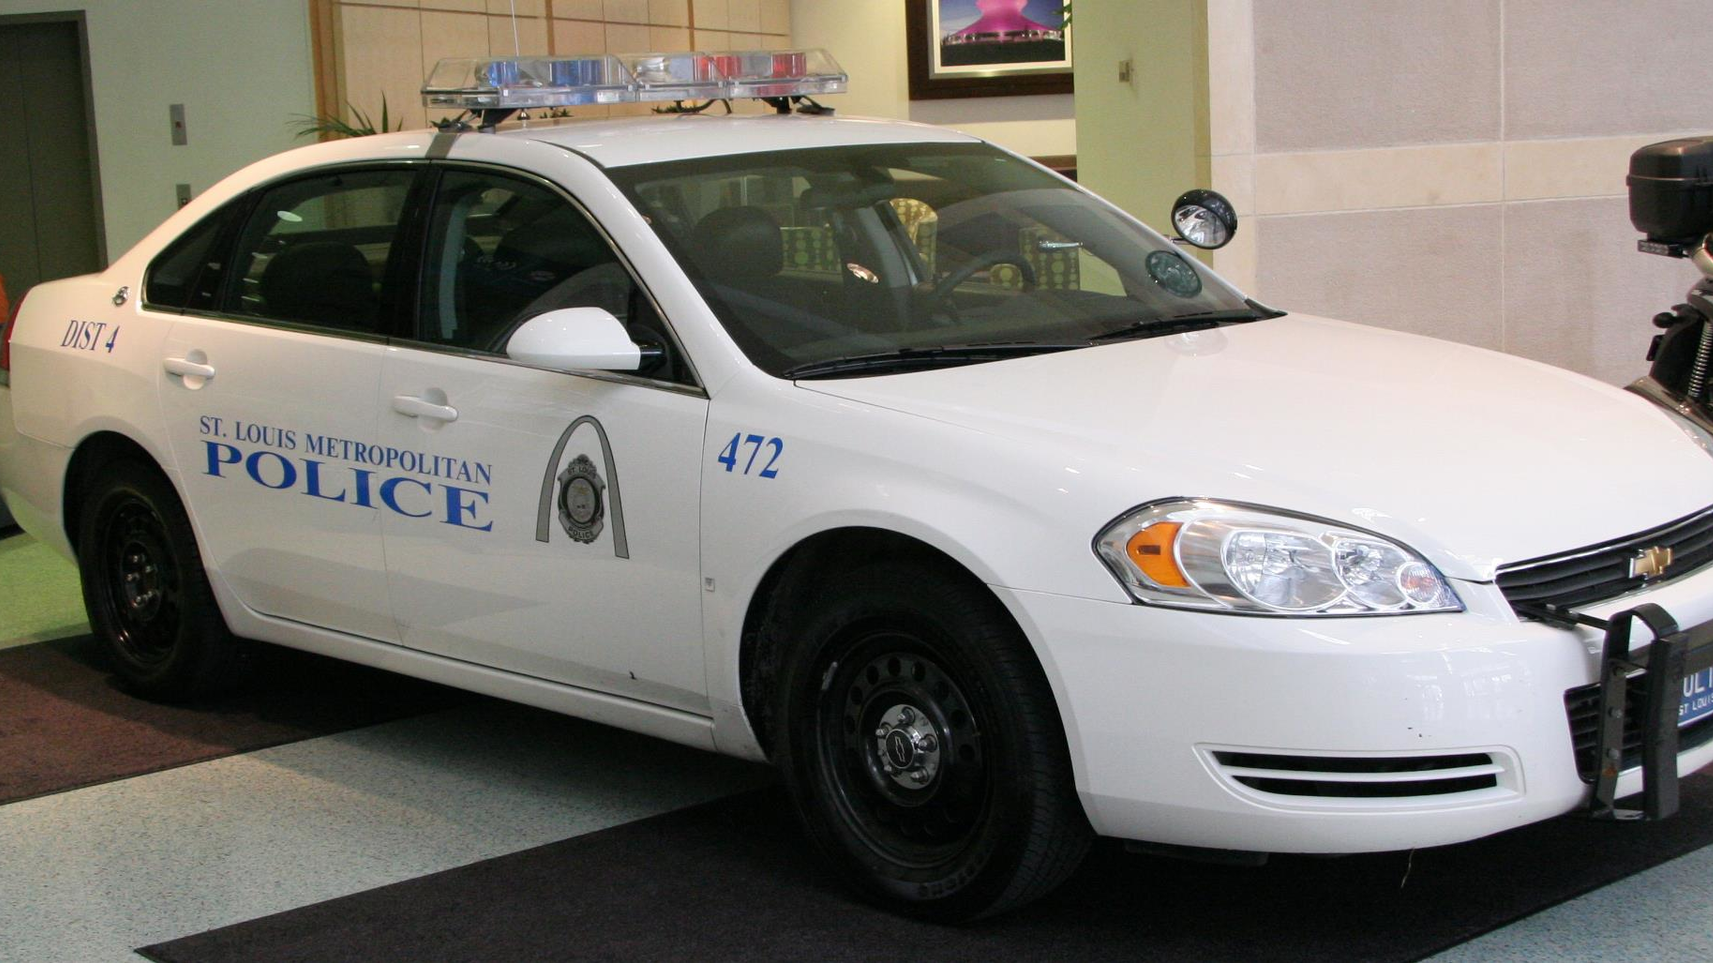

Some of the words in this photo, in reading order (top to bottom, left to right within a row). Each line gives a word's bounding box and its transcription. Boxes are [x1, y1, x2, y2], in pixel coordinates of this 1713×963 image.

[60, 319, 107, 351] DIST
[105, 325, 120, 353] 4
[200, 415, 227, 438] ST.
[235, 421, 297, 450] LOUIS
[304, 433, 493, 486] METROPOLITAN
[717, 432, 784, 479] 472
[200, 440, 494, 532] POLICE
[568, 525, 595, 539] POLICE
[1678, 702, 1690, 716] ST
